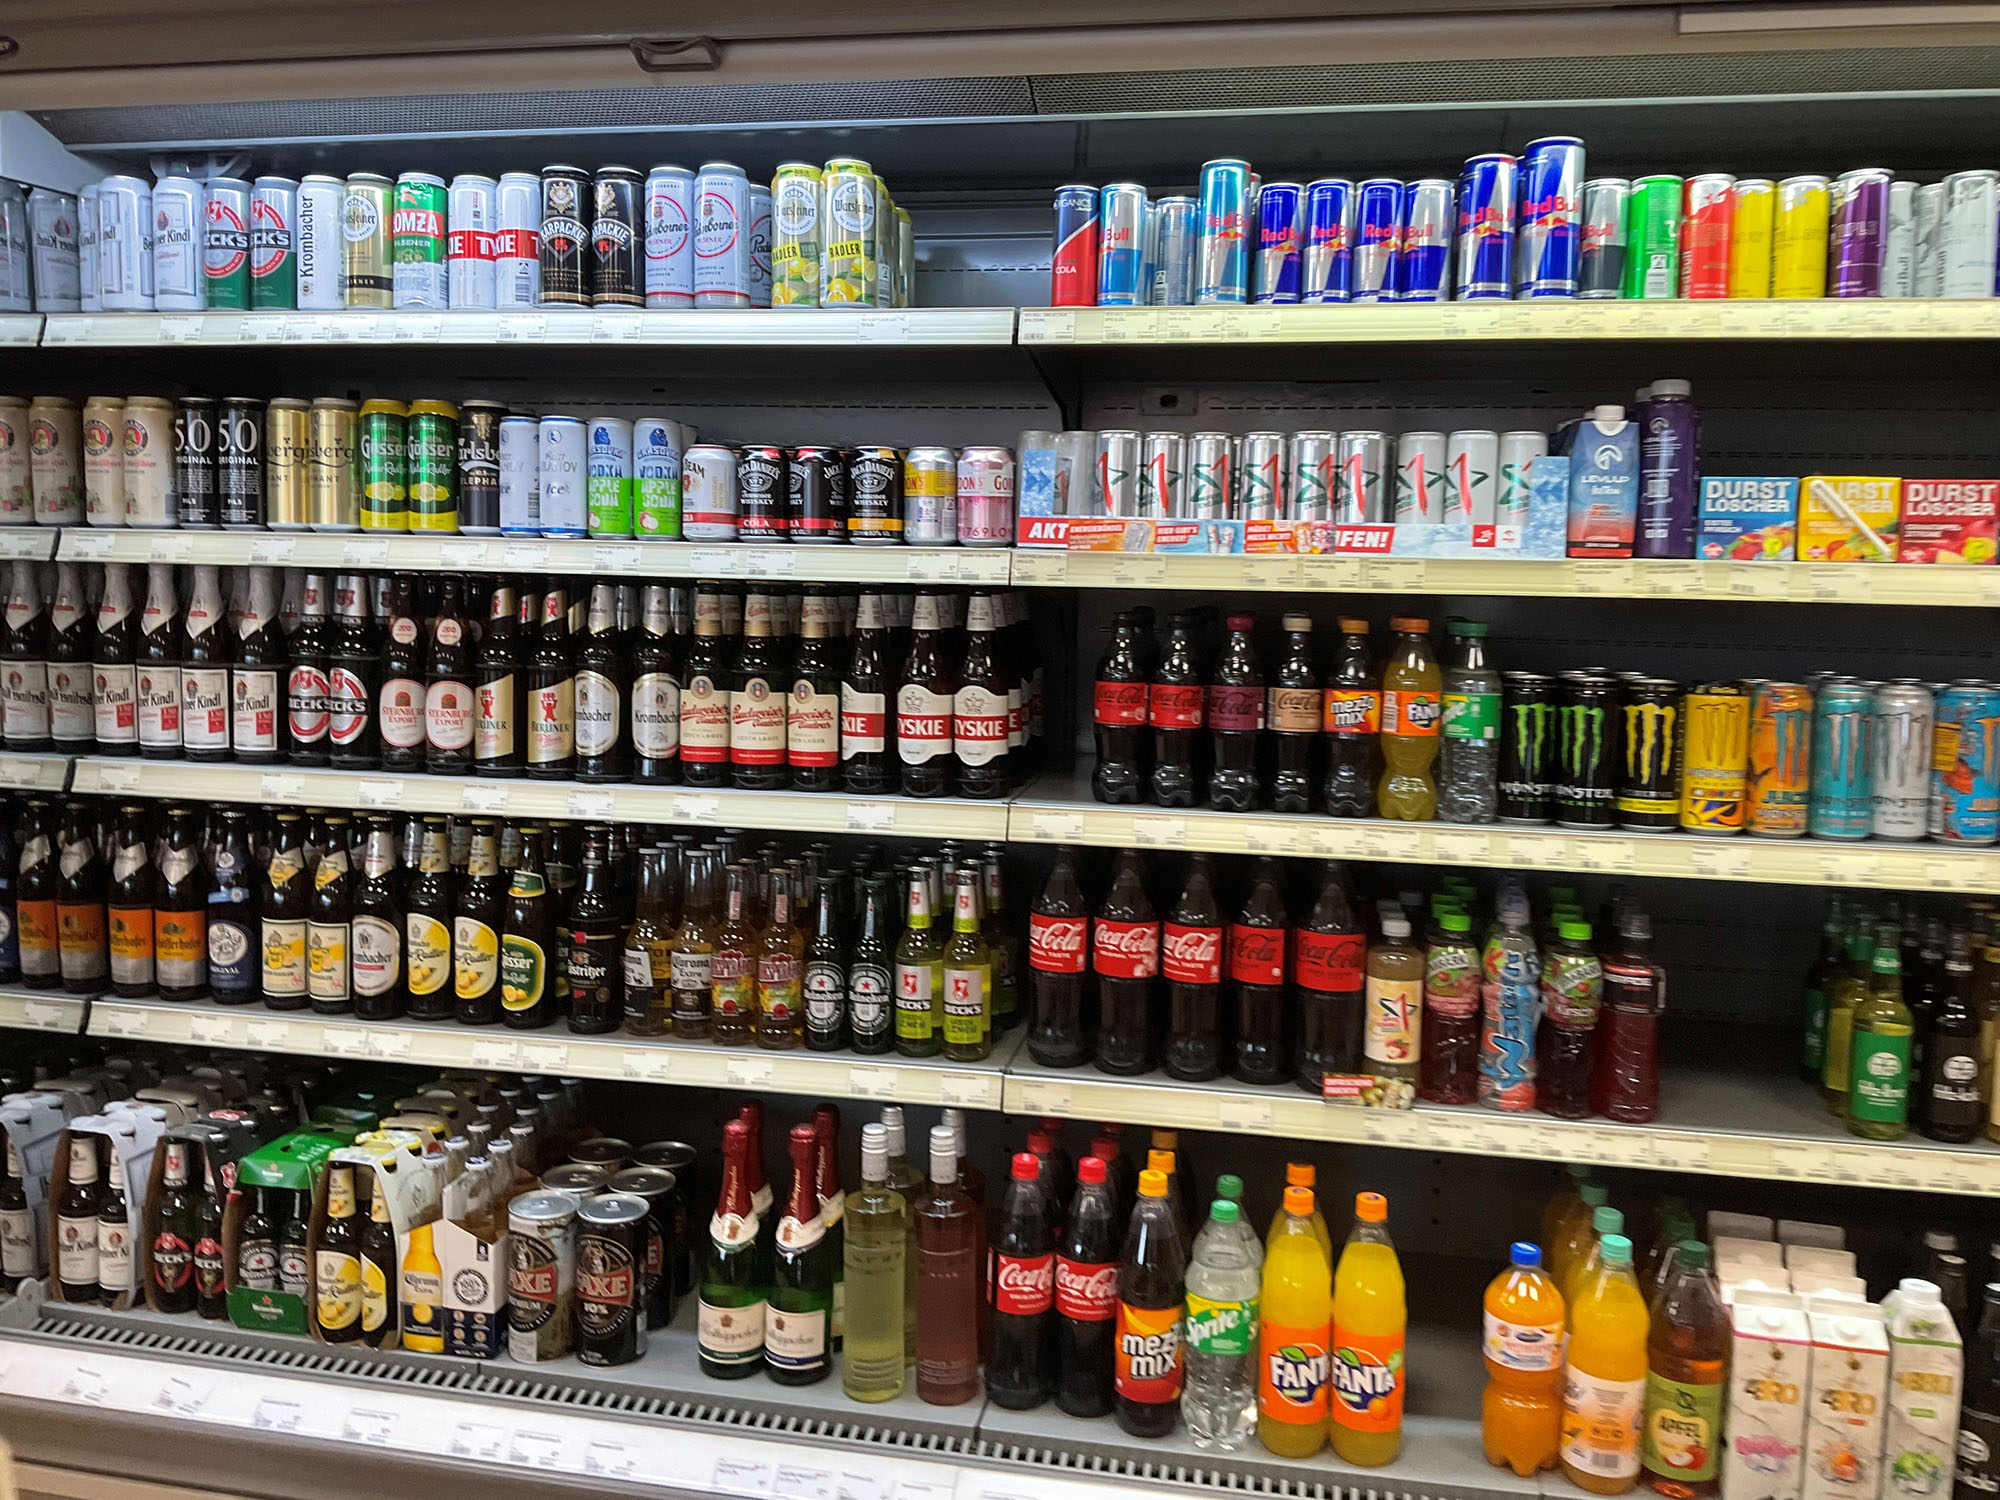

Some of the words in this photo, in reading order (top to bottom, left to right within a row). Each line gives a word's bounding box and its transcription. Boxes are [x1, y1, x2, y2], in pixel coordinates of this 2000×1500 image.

[1522, 195, 1551, 216] Red
[167, 228, 191, 244] Kindl
[300, 195, 314, 278] Krombacher
[541, 221, 587, 243] KARPACKIE
[1261, 227, 1287, 242] Red
[1365, 224, 1392, 238] Red
[829, 243, 861, 258] RADLER
[1055, 266, 1077, 274] COLA
[408, 435, 454, 460] Gösser
[640, 481, 677, 495] APPLE
[1706, 481, 1791, 499] DURST
[1908, 484, 1991, 502] DURST
[642, 494, 676, 508] SODA
[854, 499, 888, 507] WHISKEY
[743, 519, 769, 528] COLA
[1028, 523, 1069, 540] AKT
[106, 688, 129, 703] Kindl
[151, 692, 174, 706] Kindl
[198, 694, 221, 709] Kindl
[246, 696, 270, 711] Kindl
[1330, 695, 1376, 715] mezzo
[388, 716, 417, 724] EXPORT
[1335, 708, 1365, 727] mix
[672, 954, 710, 969] Corona
[945, 1005, 982, 1015] BECK'S
[1186, 1309, 1239, 1347] Sprite
[1130, 1352, 1177, 1379] mix
[1332, 1355, 1396, 1394] FANTA
